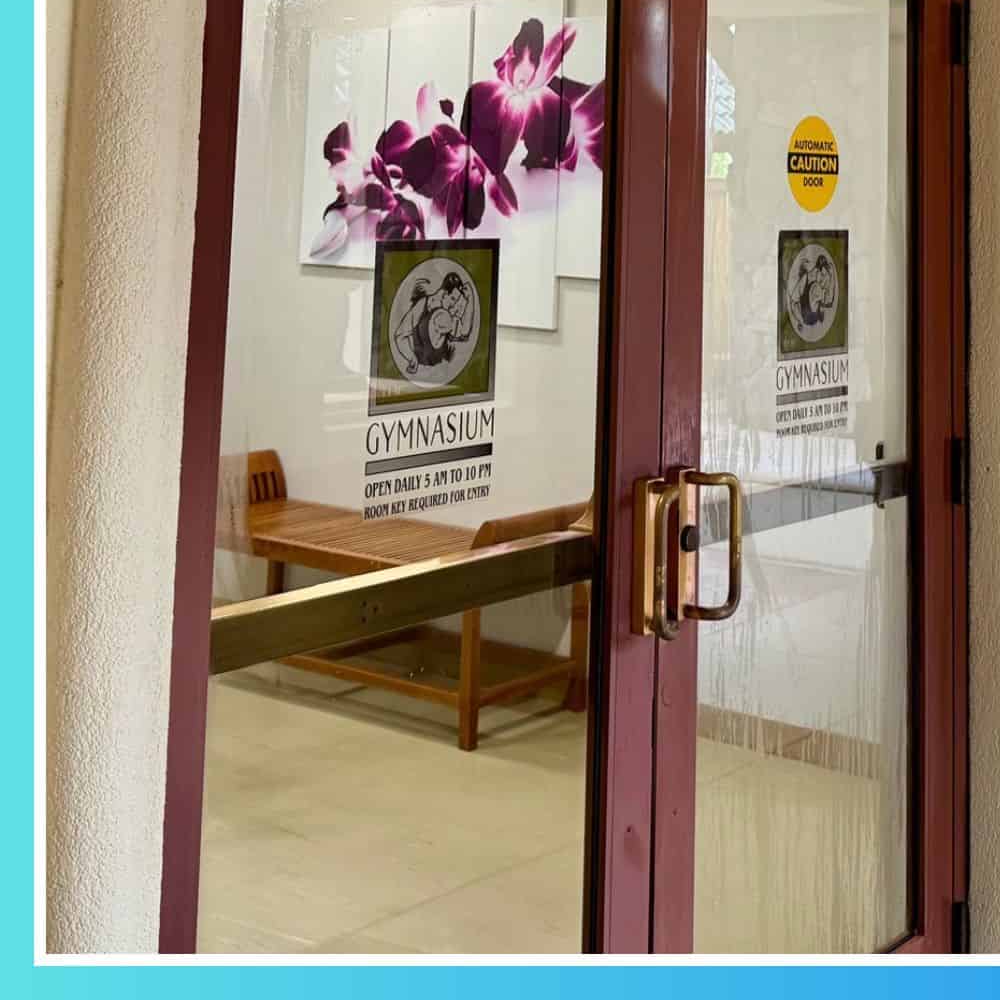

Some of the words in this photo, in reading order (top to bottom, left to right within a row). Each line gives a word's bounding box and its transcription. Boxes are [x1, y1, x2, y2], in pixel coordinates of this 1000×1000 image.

[794, 140, 833, 151] AUTOMATIC
[791, 155, 837, 172] CAUTION
[803, 176, 823, 186] DOOR
[776, 359, 848, 391] GYMNASIUM
[366, 407, 495, 456] GYMNASIUM
[364, 480, 392, 499] OPEN
[394, 473, 422, 493] DAILY
[424, 473, 431, 489] 5
[433, 469, 448, 487] AM
[449, 467, 463, 484] TO
[465, 466, 476, 480] 10
[478, 462, 492, 479] PM
[363, 503, 390, 521] ROOM
[391, 499, 406, 516] KEY
[408, 492, 448, 511] REQUIRED
[450, 489, 465, 504] FOR
[467, 485, 490, 501] ENTRY
